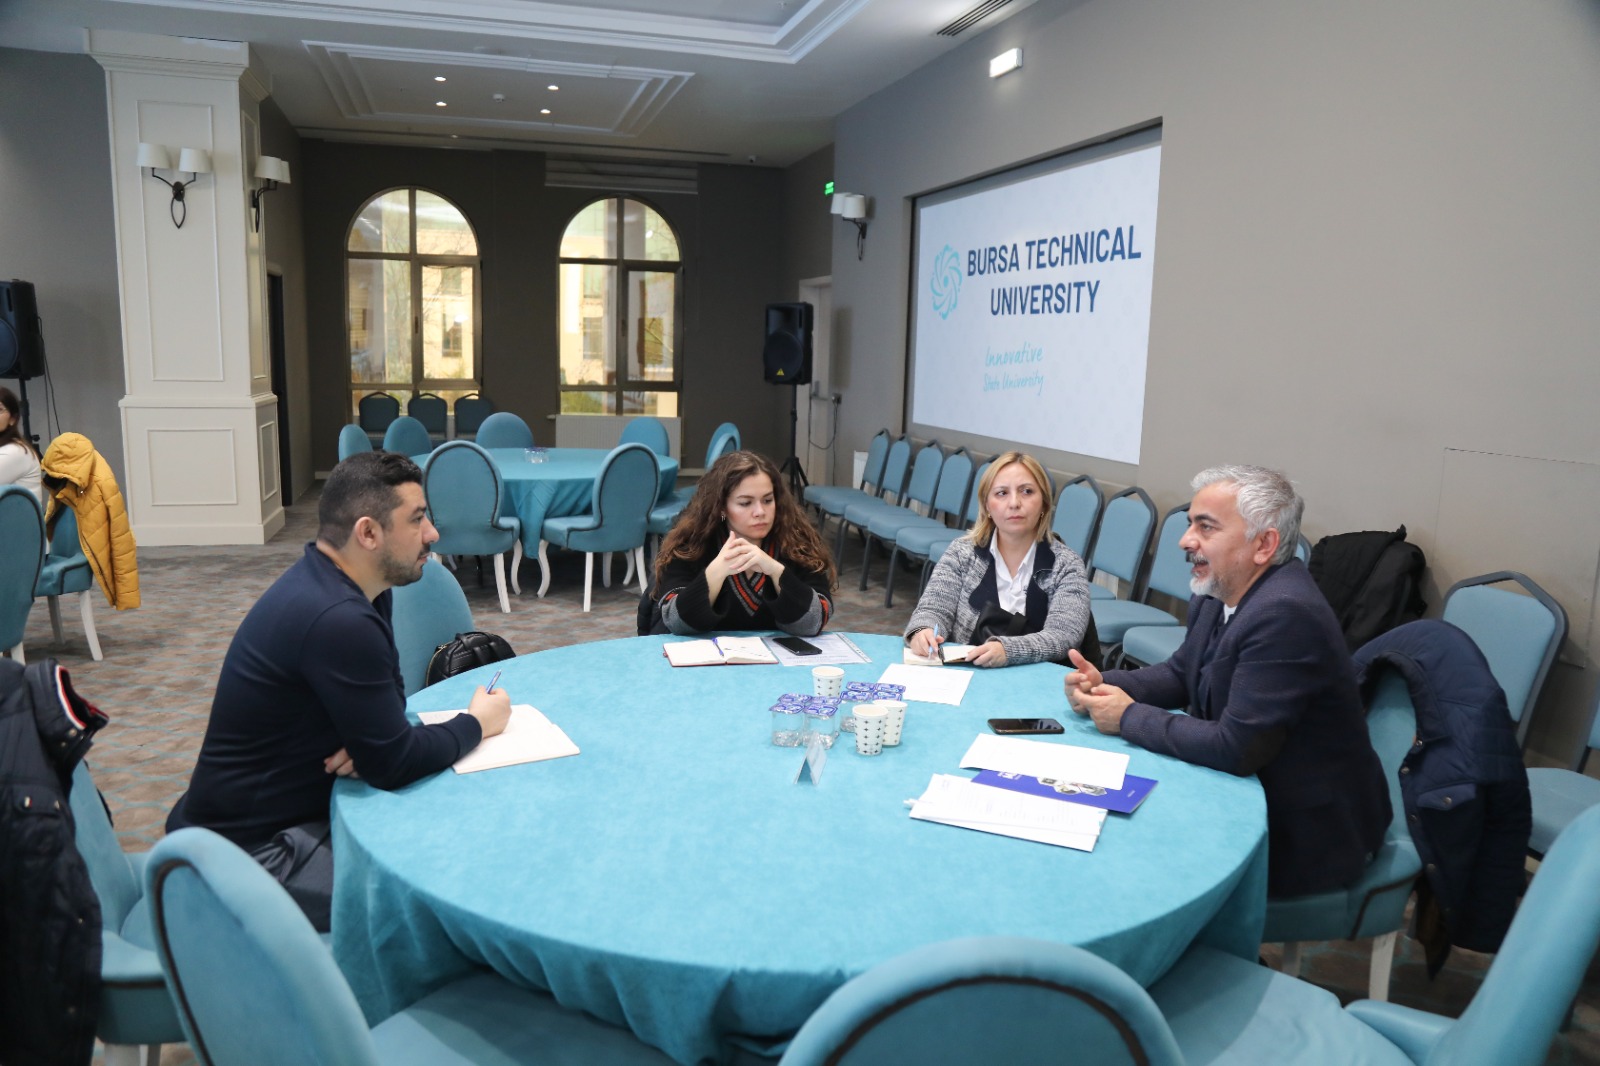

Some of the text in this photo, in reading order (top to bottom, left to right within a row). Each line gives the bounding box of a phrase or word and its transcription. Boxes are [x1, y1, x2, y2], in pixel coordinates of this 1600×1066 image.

[966, 224, 1142, 277] BURSA TECHNICAL
[990, 279, 1101, 316] UNIVERSITY
[985, 341, 1044, 367] Innovative
[983, 369, 1044, 396] State University
